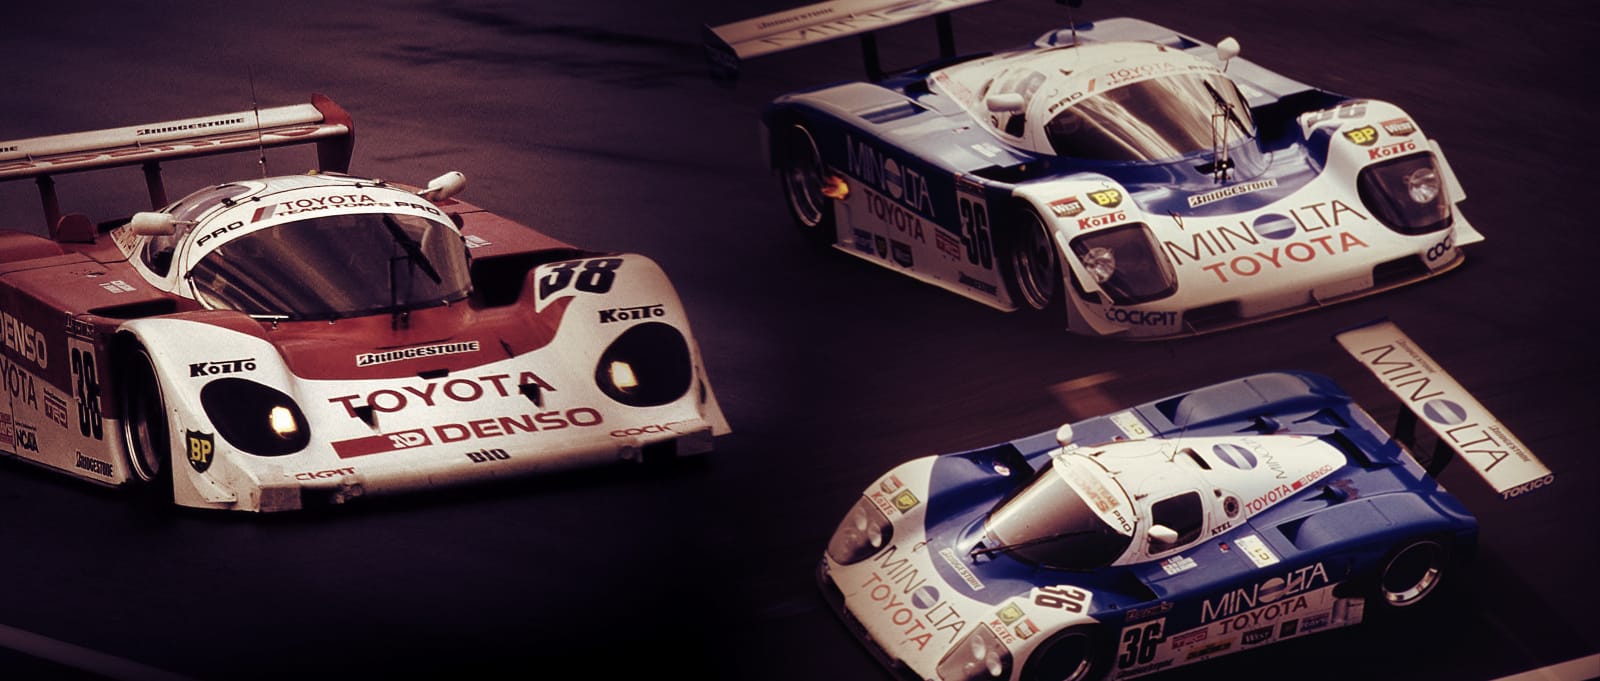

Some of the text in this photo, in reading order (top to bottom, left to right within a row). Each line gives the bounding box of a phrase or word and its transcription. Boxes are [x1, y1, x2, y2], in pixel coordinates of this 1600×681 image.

[1106, 62, 1176, 81] TOYOTA
[1048, 91, 1083, 114] PRO
[1348, 127, 1376, 144] BP
[279, 194, 375, 211] TOYOTA
[1091, 189, 1119, 206] BP
[1189, 180, 1276, 207] BRIDGESTONE
[276, 205, 329, 217] TEAM
[394, 201, 442, 217] PRO
[863, 187, 926, 245] TOYOTA
[196, 220, 245, 248] PRO
[959, 196, 993, 271] 36
[1202, 231, 1369, 283] TOYOTA
[538, 257, 624, 301] 38
[1104, 305, 1178, 326] COCKPIT
[358, 341, 480, 367] BRIDGESTONE
[71, 346, 104, 441] 38
[327, 371, 558, 419] TOYOTA
[432, 407, 605, 444] DENSO
[190, 436, 212, 464] BP
[1245, 484, 1293, 516] TOYOTA
[1502, 475, 1555, 500] TOKICO
[1111, 509, 1133, 533] PRO
[861, 572, 934, 652] TOYOTA
[1034, 584, 1087, 615] 36
[1218, 595, 1308, 635] TOYOTA
[1118, 626, 1166, 671] 36
